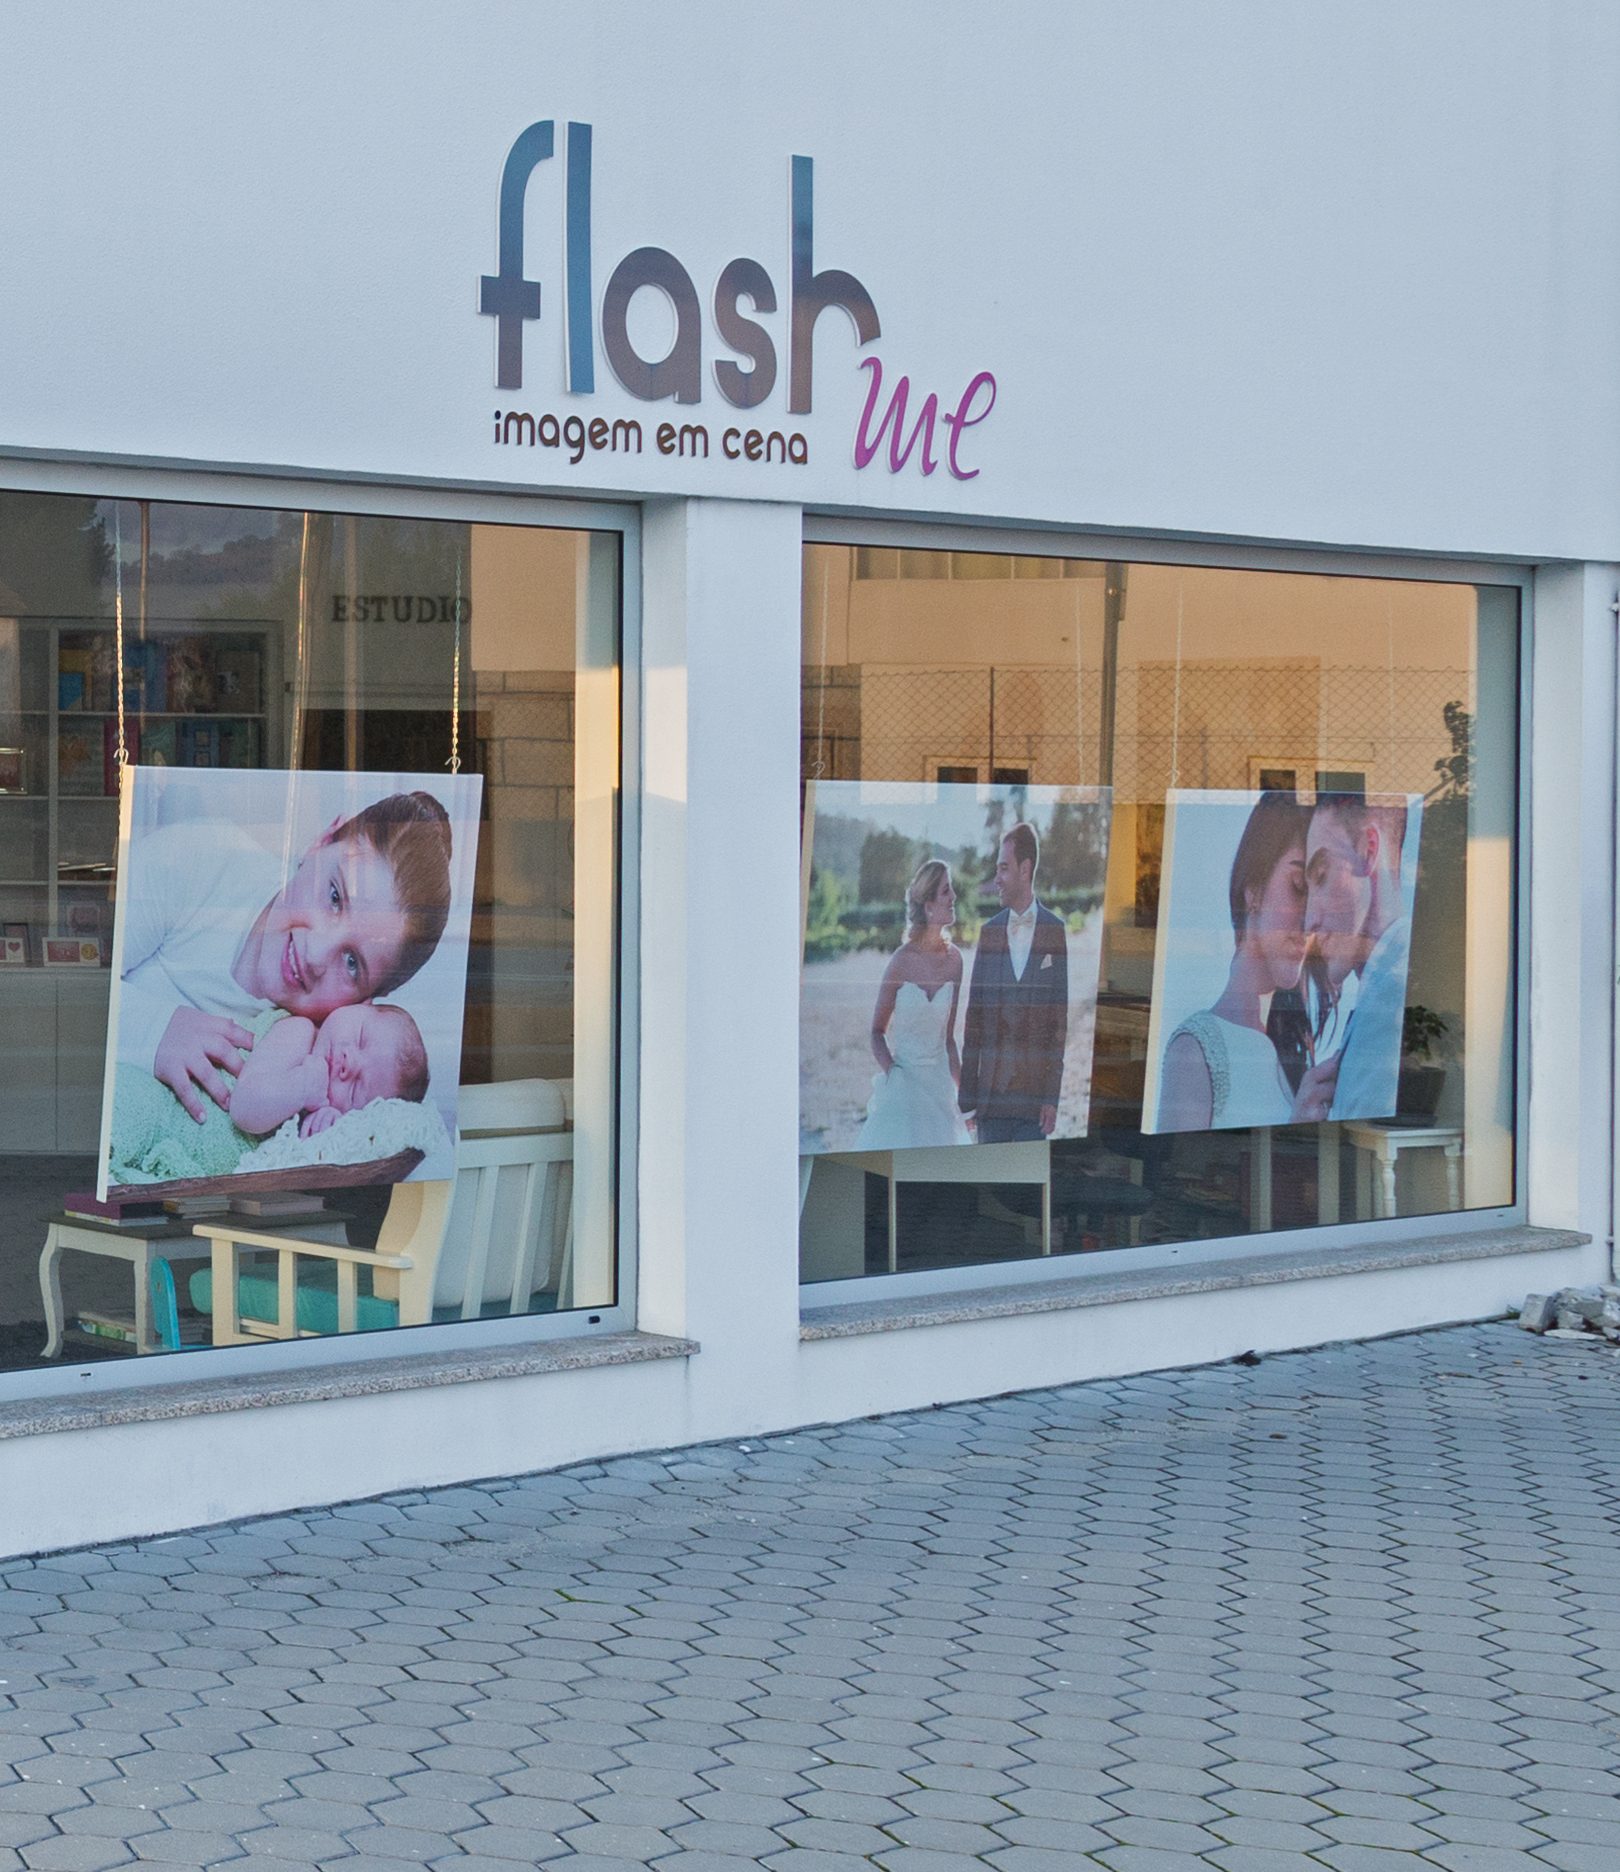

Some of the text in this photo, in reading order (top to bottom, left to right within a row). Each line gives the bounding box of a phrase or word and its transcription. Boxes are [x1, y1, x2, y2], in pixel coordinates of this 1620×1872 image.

[476, 119, 997, 480] flash me
[493, 409, 808, 465] imagem em cena
